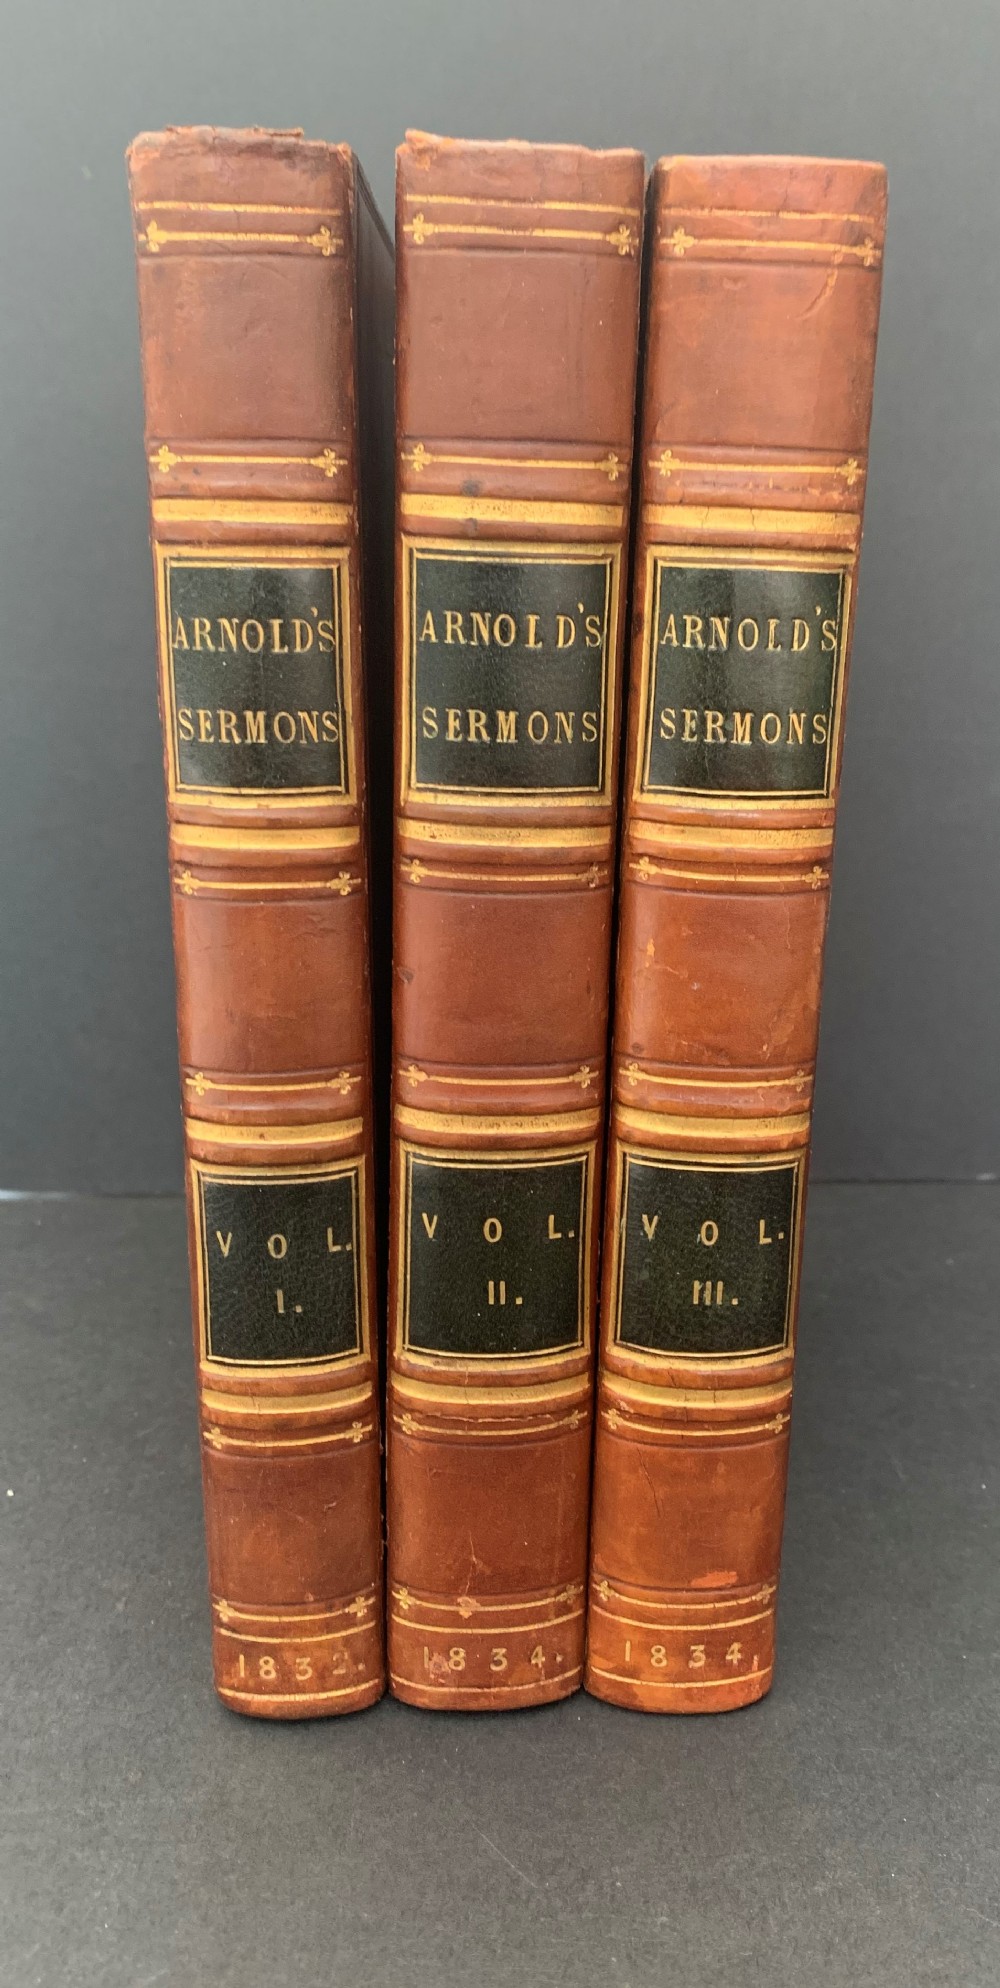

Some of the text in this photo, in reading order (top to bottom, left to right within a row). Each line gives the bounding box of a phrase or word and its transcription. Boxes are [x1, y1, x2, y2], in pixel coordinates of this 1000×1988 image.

[172, 606, 337, 653] ARNOLD'S
[419, 602, 602, 649] ARNOLD'S
[660, 605, 839, 652] ARNOLD'S
[177, 707, 339, 744] SERMONS
[421, 706, 598, 744] SERMONS
[660, 707, 827, 745] SERMONS
